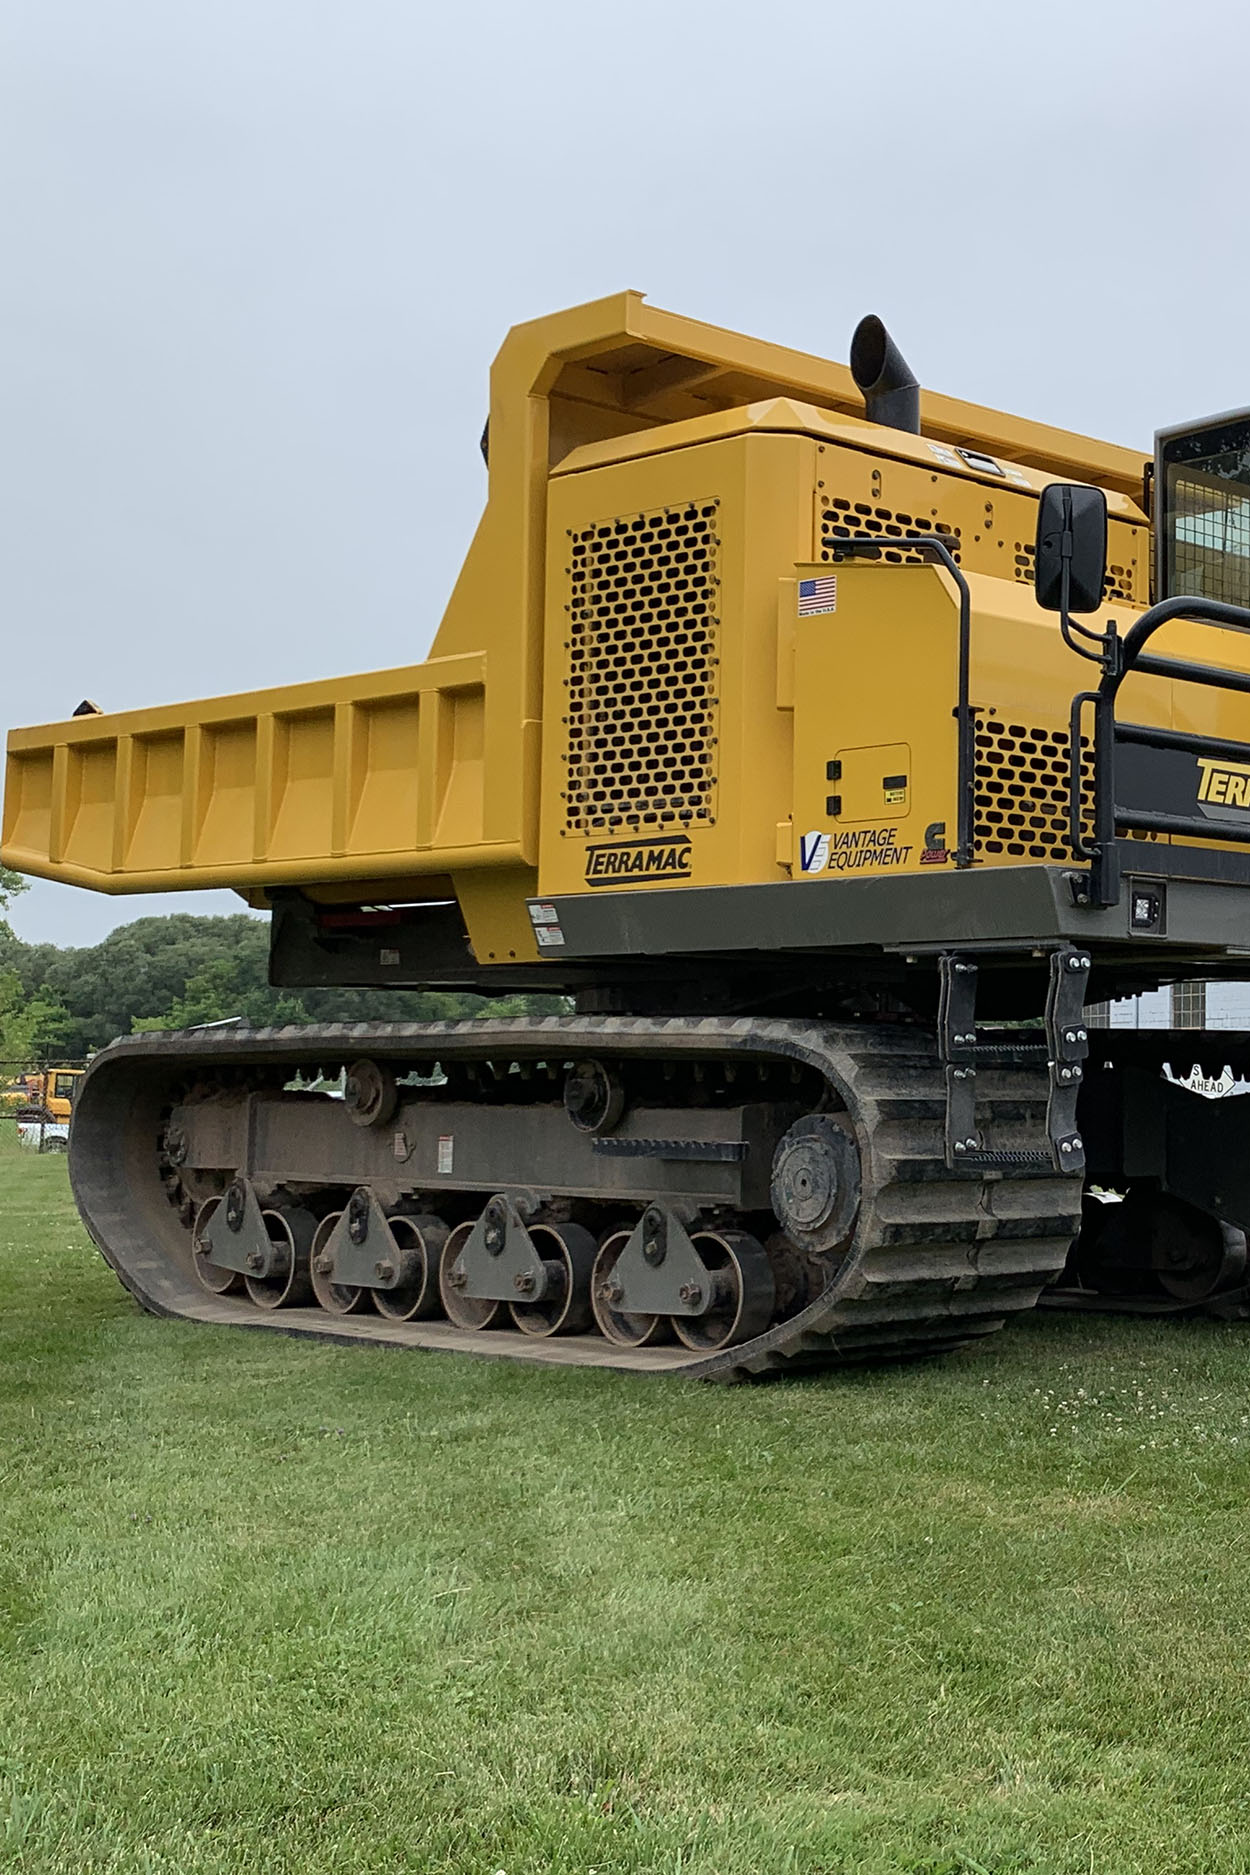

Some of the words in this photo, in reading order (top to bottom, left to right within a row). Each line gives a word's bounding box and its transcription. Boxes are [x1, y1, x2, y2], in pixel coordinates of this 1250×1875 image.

[834, 828, 897, 849] VANTAGE
[585, 834, 692, 875] TERRAMAC
[828, 846, 913, 871] EQUIPMENT
[1191, 1080, 1224, 1093] AHEAD
